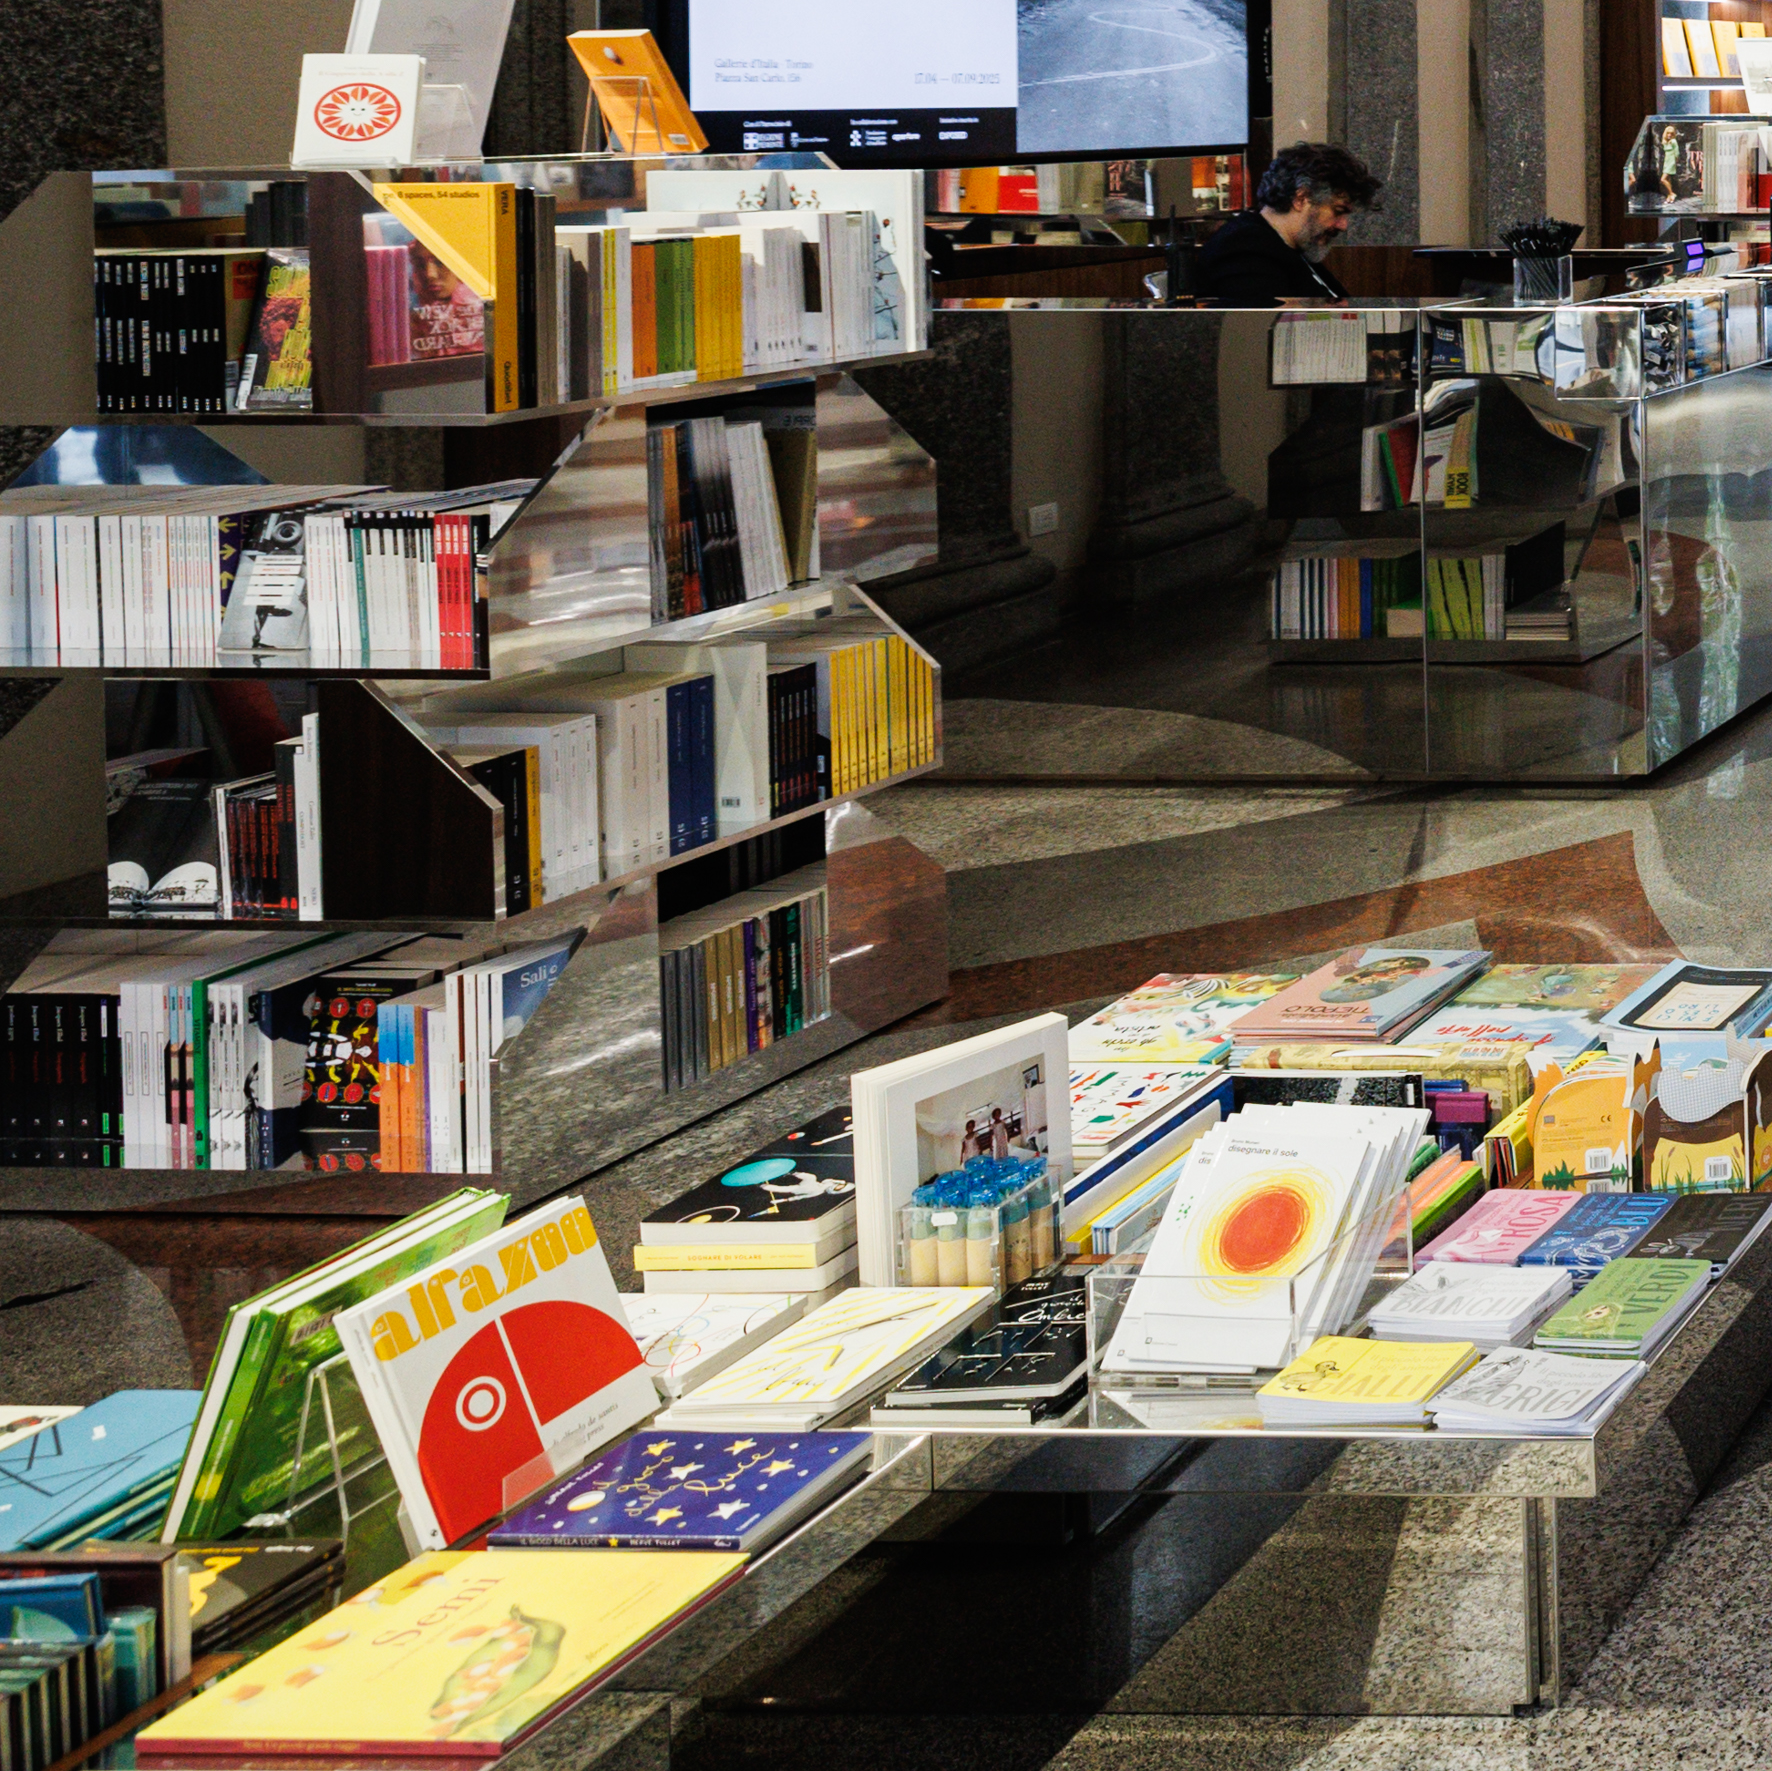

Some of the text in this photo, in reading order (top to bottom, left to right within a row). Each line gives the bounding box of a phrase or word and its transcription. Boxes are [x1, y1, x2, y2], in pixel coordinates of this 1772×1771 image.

[450, 190, 480, 199] studios
[1281, 1004, 1370, 1016] TIEPOLO
[1228, 1145, 1271, 1155] disegnare
[1280, 1149, 1299, 1158] sole
[1506, 1194, 1573, 1240] ROSA
[1607, 1195, 1670, 1228] BLU
[687, 1254, 722, 1262] SOGNARE
[734, 1253, 763, 1261] VOLARE
[1619, 1264, 1704, 1316] VERDI
[1390, 1296, 1523, 1321] BIANCHI
[1309, 1373, 1433, 1399] GIALLI
[1486, 1383, 1594, 1415] GRIGI
[529, 1537, 554, 1545] GIOCO
[555, 1537, 578, 1545] DELLA
[579, 1537, 599, 1545] LUCE
[371, 1574, 506, 1649] Semi
